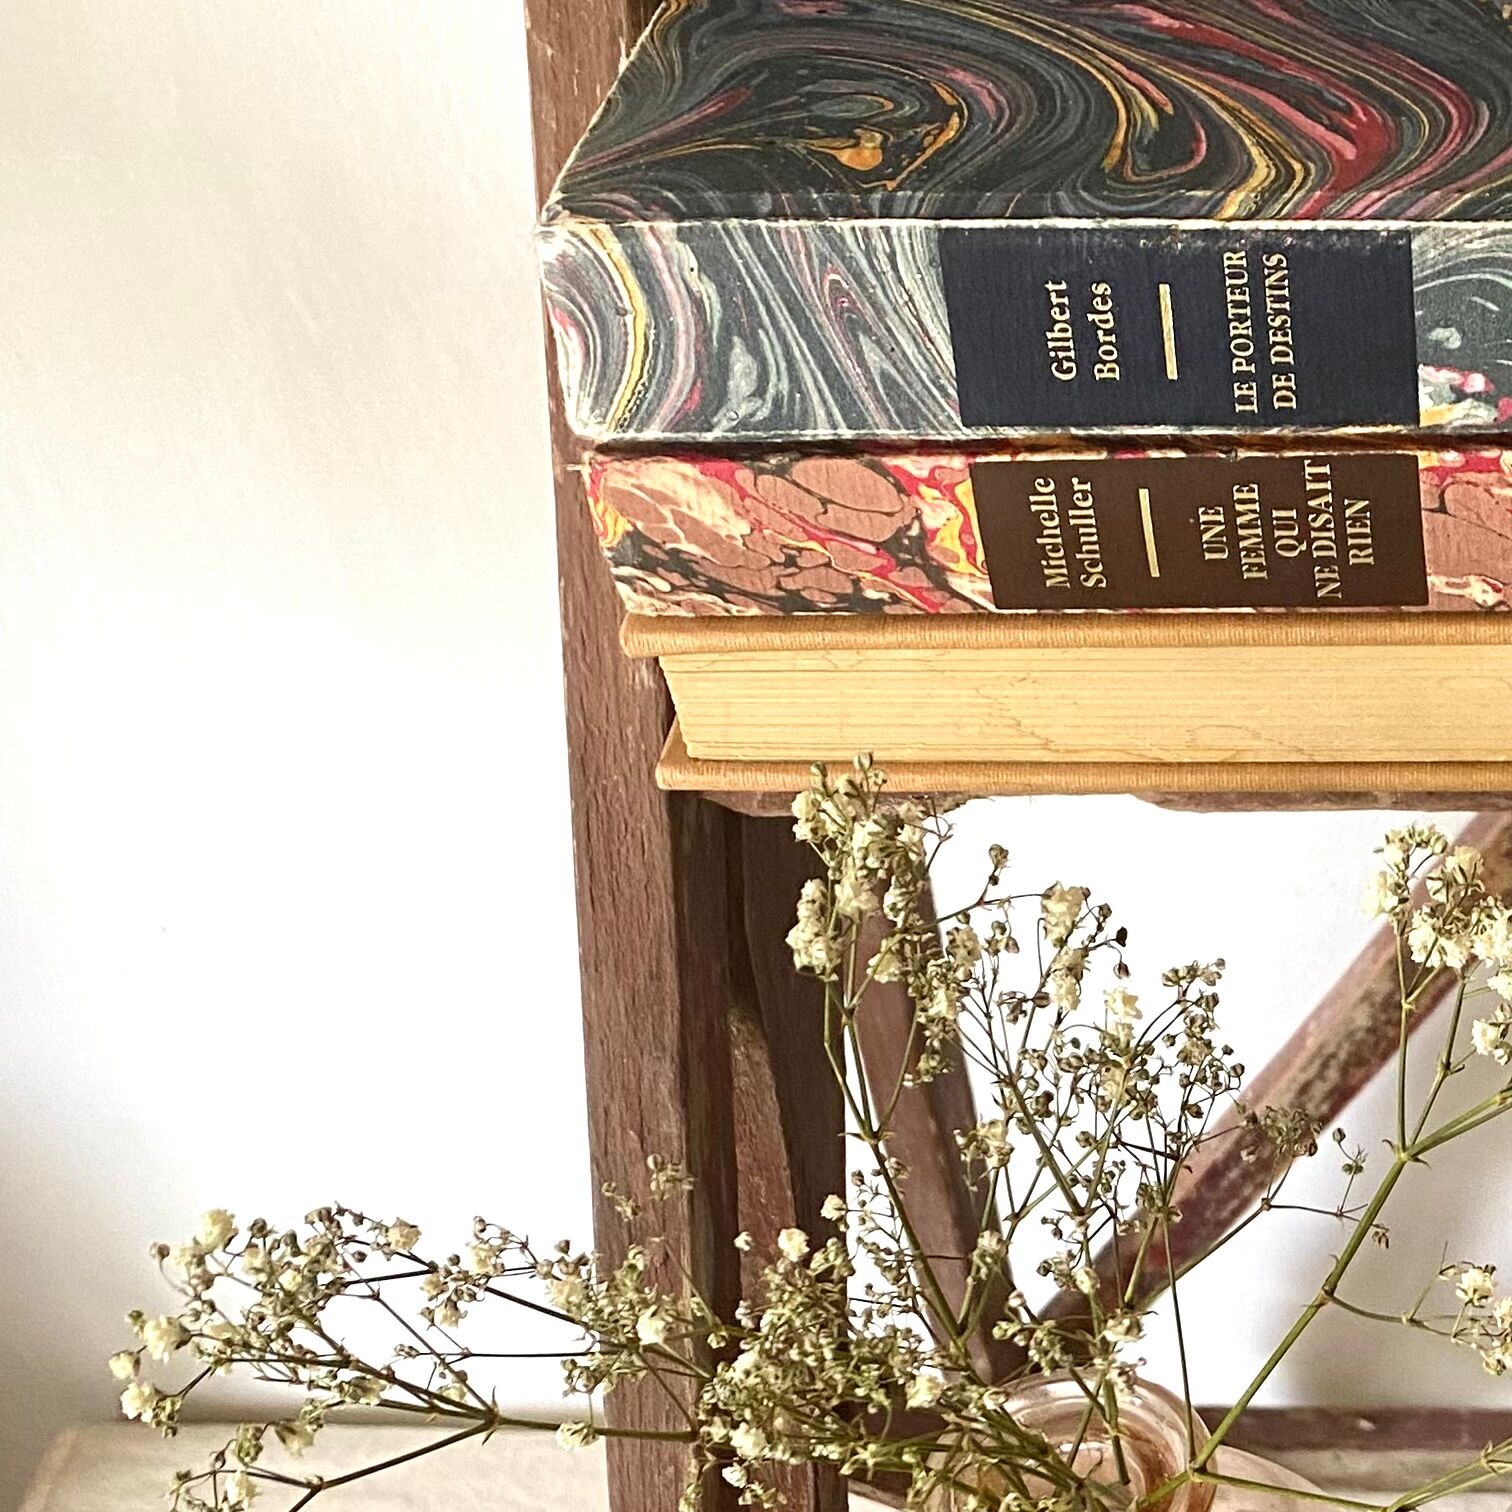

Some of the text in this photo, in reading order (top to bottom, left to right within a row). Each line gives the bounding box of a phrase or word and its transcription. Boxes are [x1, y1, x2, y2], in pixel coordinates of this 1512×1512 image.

[1044, 279, 1078, 381] Gilbert
[1087, 282, 1120, 381] Bordes
[1223, 250, 1258, 414] LE PORTEUR
[1262, 253, 1296, 410] DE DESTINS
[1029, 476, 1070, 589] Michelle
[1068, 476, 1107, 588] Schuller
[1198, 505, 1229, 560] UNE
[1232, 483, 1268, 580] FEMME
[1271, 507, 1307, 558] QUI
[1303, 460, 1342, 599] NE DISAIT
[1344, 498, 1375, 566] RIEN
